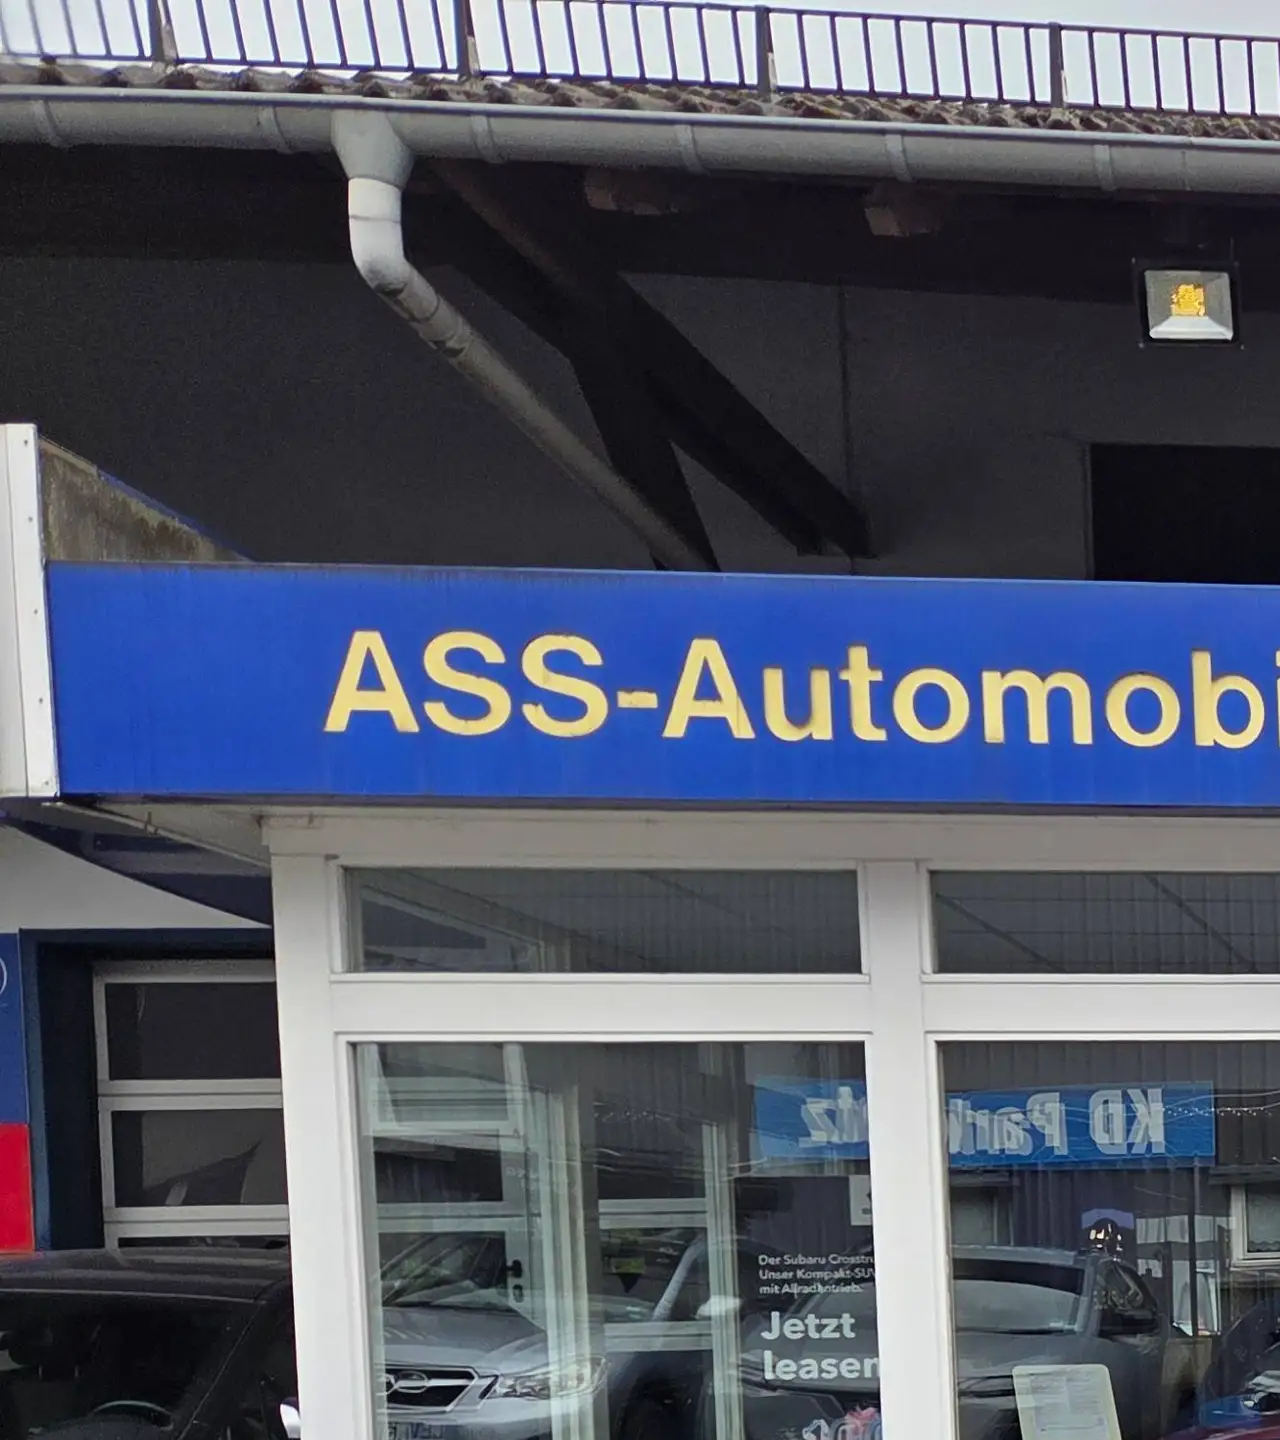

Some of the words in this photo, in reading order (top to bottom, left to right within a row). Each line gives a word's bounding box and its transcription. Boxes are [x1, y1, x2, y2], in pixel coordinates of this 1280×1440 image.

[758, 1254, 781, 1265] Der
[784, 1253, 826, 1265] Subaru
[828, 1253, 874, 1265] Crosstr
[759, 1269, 794, 1280] Unser
[759, 1283, 779, 1294] mit
[760, 1311, 856, 1340] Jetzt
